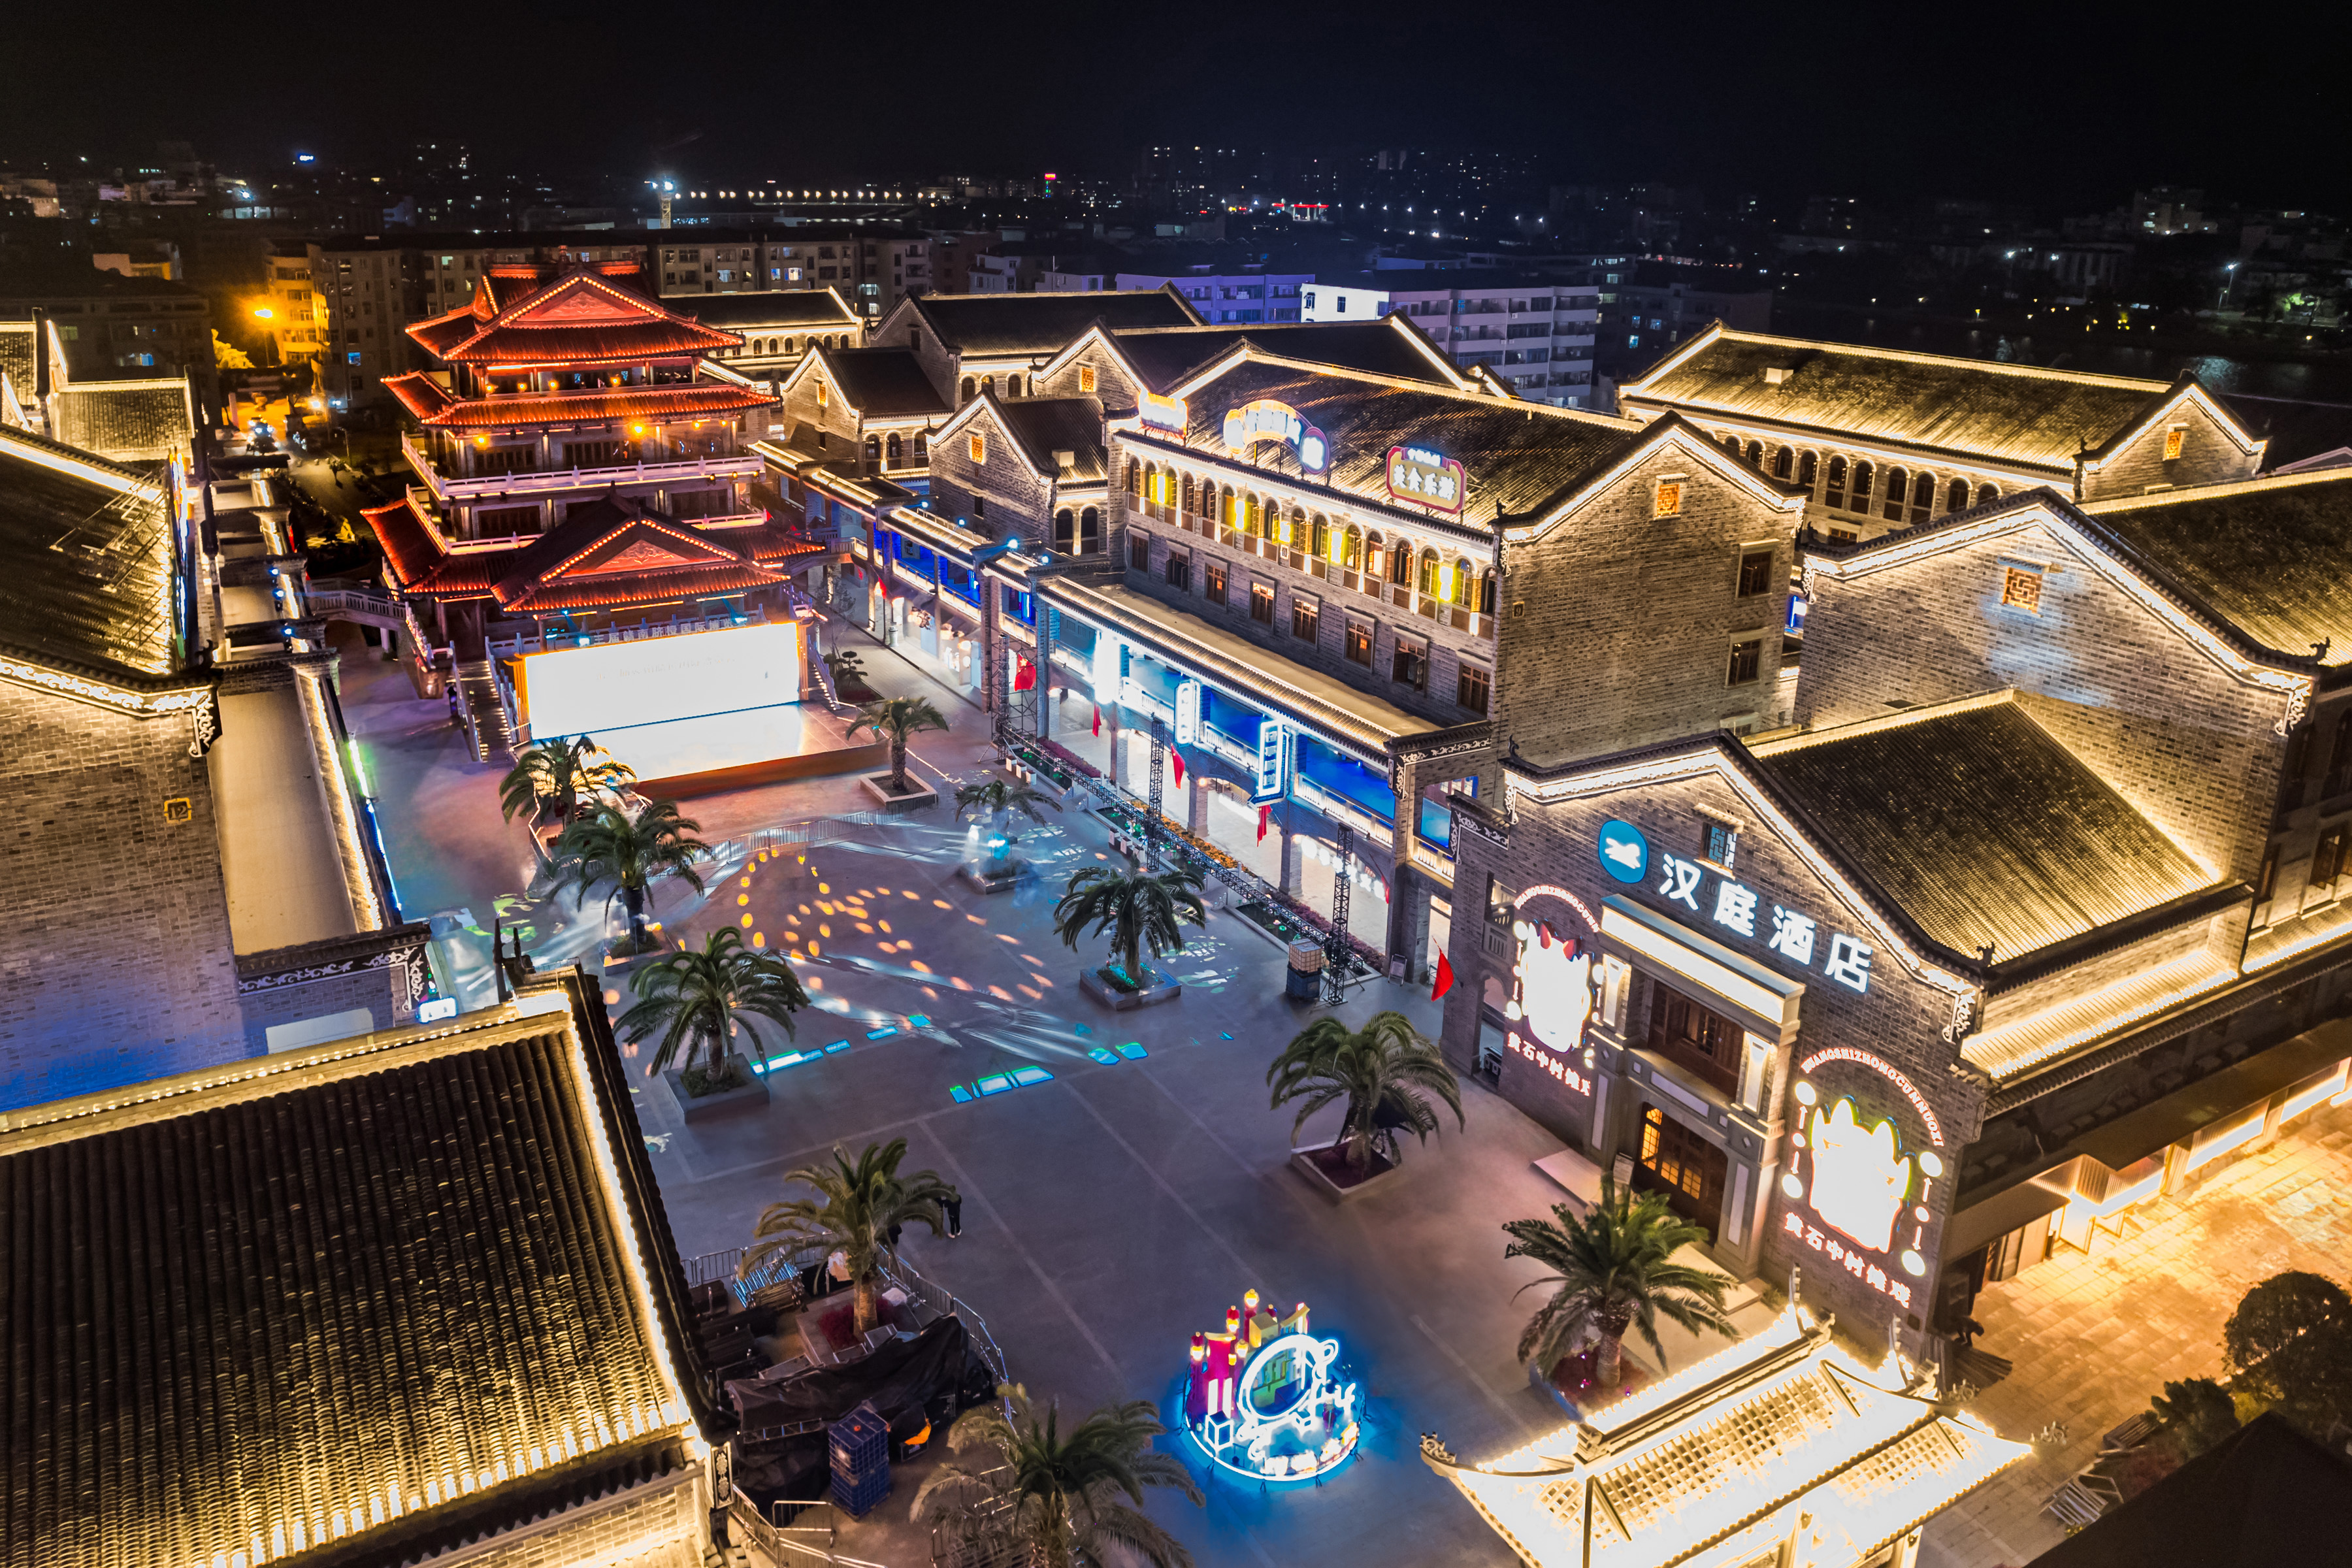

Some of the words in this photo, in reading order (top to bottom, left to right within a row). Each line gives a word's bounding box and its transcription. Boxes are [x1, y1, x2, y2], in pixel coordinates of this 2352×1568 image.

[579, 617, 746, 647] 三届赣南脐橙国际博览
[171, 806, 188, 819] 12
[1706, 882, 1718, 896] 10
[1659, 853, 1873, 993] 汉庭酒店
[1801, 1048, 1944, 1147] HUANGSHIZHONGCUNNUOXI
